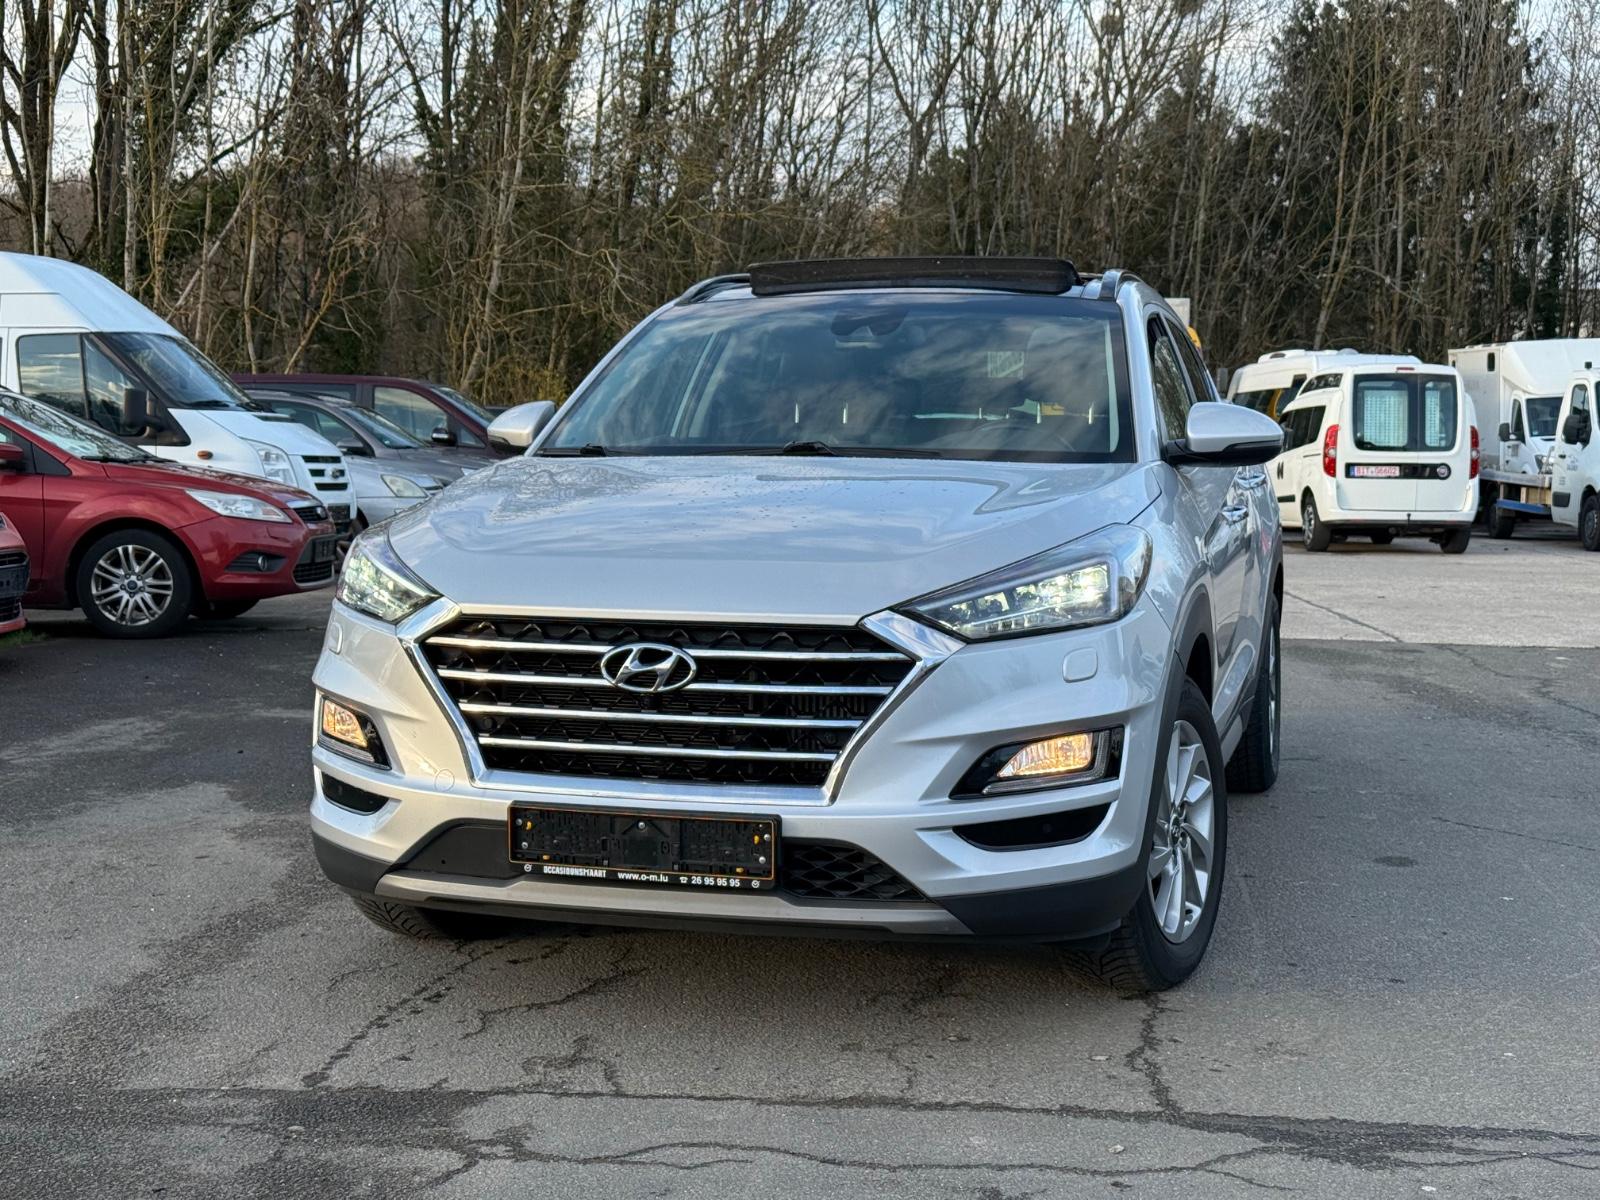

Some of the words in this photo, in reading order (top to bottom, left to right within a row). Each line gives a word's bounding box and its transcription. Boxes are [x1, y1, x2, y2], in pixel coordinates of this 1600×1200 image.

[617, 872, 668, 882] www.o-m.lu
[691, 876, 702, 885] 26
[704, 877, 715, 886] 95
[716, 878, 728, 887] 95
[729, 879, 740, 888] 95
